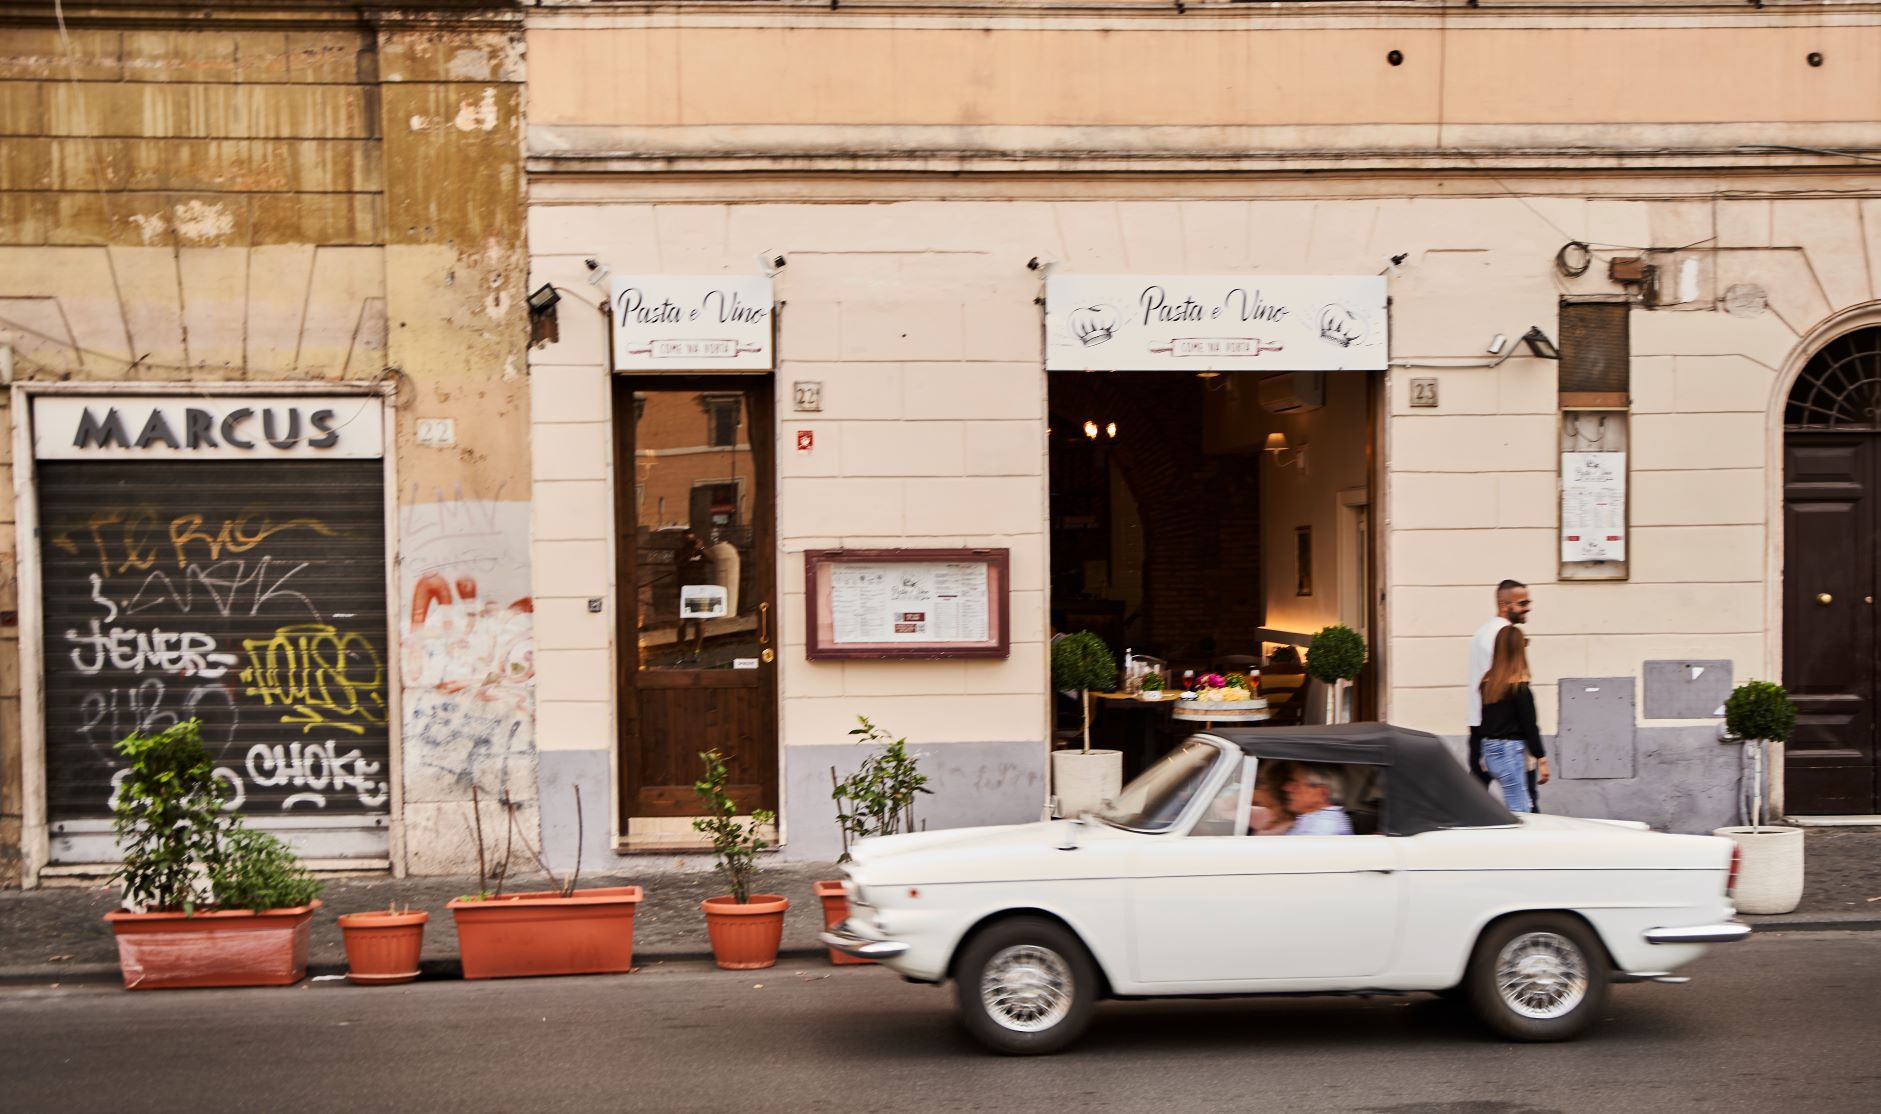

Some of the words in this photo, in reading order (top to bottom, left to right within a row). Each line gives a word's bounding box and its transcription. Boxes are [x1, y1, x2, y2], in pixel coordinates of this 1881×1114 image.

[617, 287, 683, 327] Pasta
[689, 308, 699, 321] e
[702, 289, 767, 324] Vino
[1139, 285, 1203, 326] Pasta
[1211, 306, 1221, 320] e
[1224, 288, 1289, 322] Vino
[1415, 383, 1437, 400] 23
[72, 406, 342, 450] MARCUS
[420, 421, 449, 443] 22
